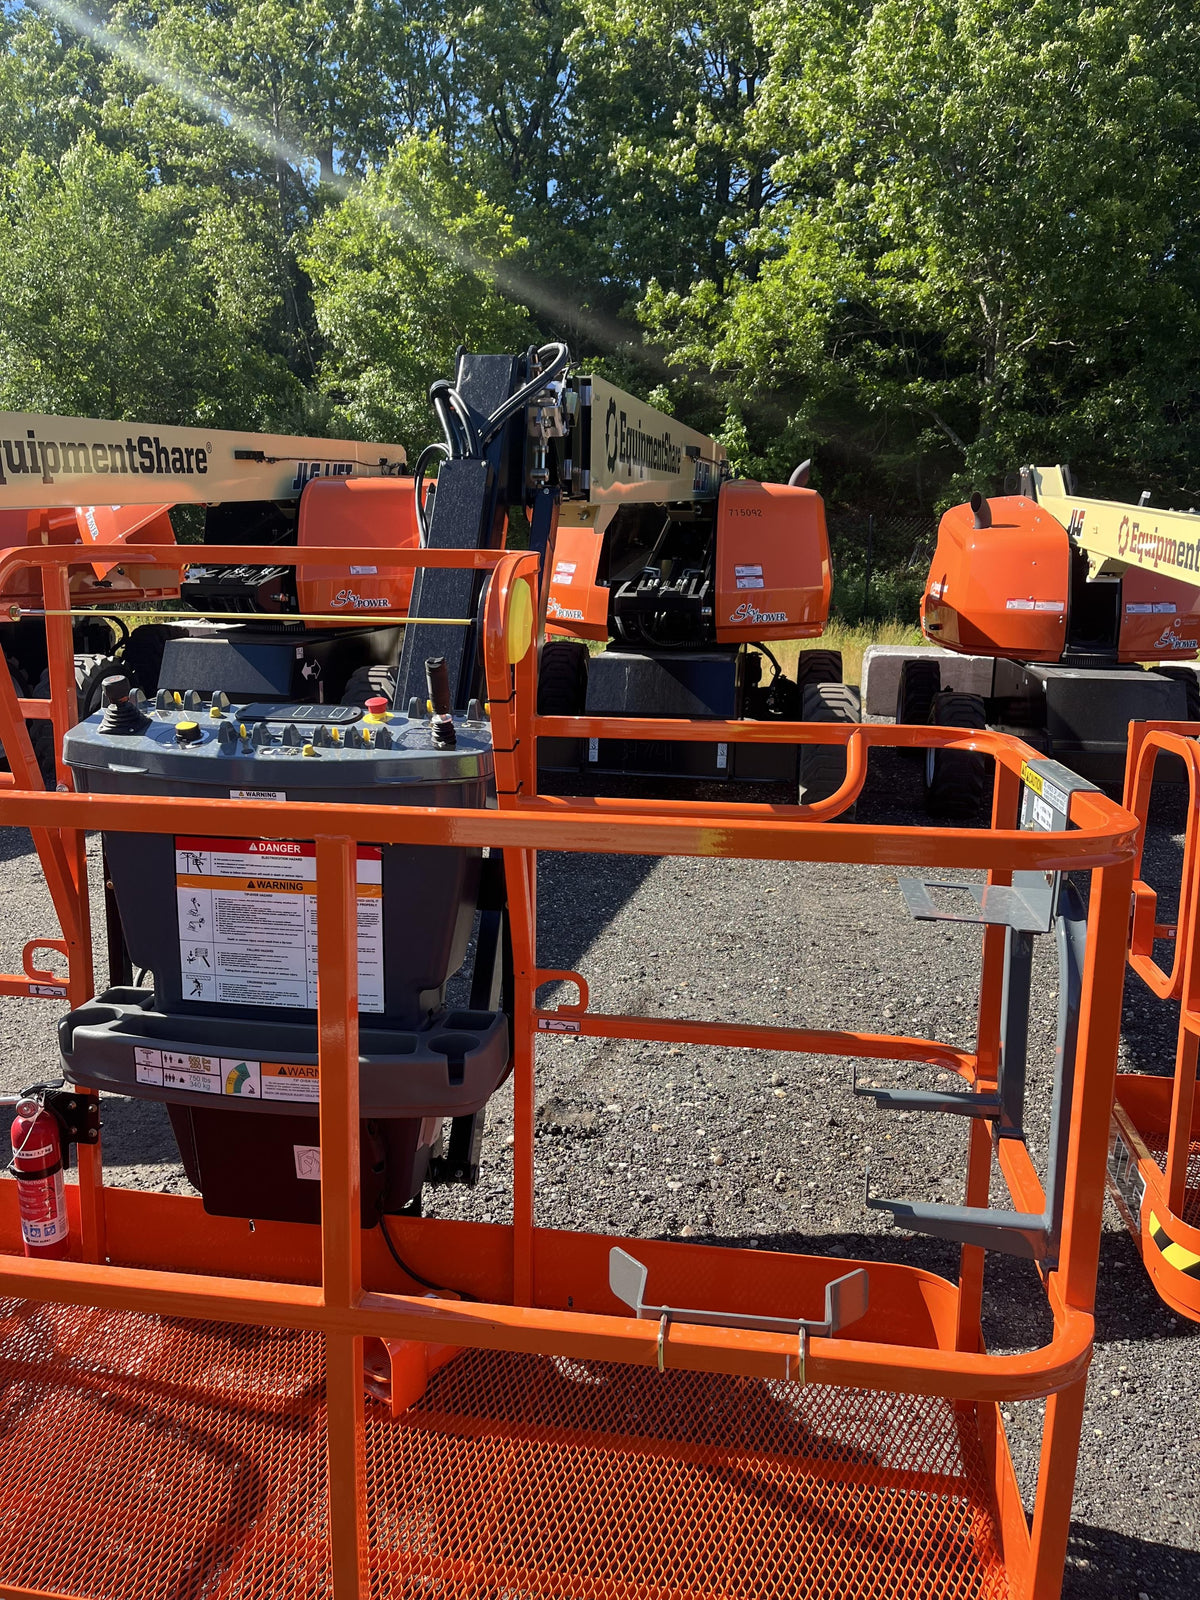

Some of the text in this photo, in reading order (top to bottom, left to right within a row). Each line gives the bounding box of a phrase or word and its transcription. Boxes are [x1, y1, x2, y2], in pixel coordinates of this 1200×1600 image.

[619, 410, 680, 478] EquipmentShare
[728, 508, 762, 517] 715092
[1067, 508, 1086, 538] JLG
[355, 597, 391, 608] POWER
[555, 608, 584, 620] POWER
[729, 603, 788, 623] Sky POWER
[1171, 638, 1198, 649] POWER
[258, 842, 301, 854] DANGER
[256, 880, 304, 891] WARNING
